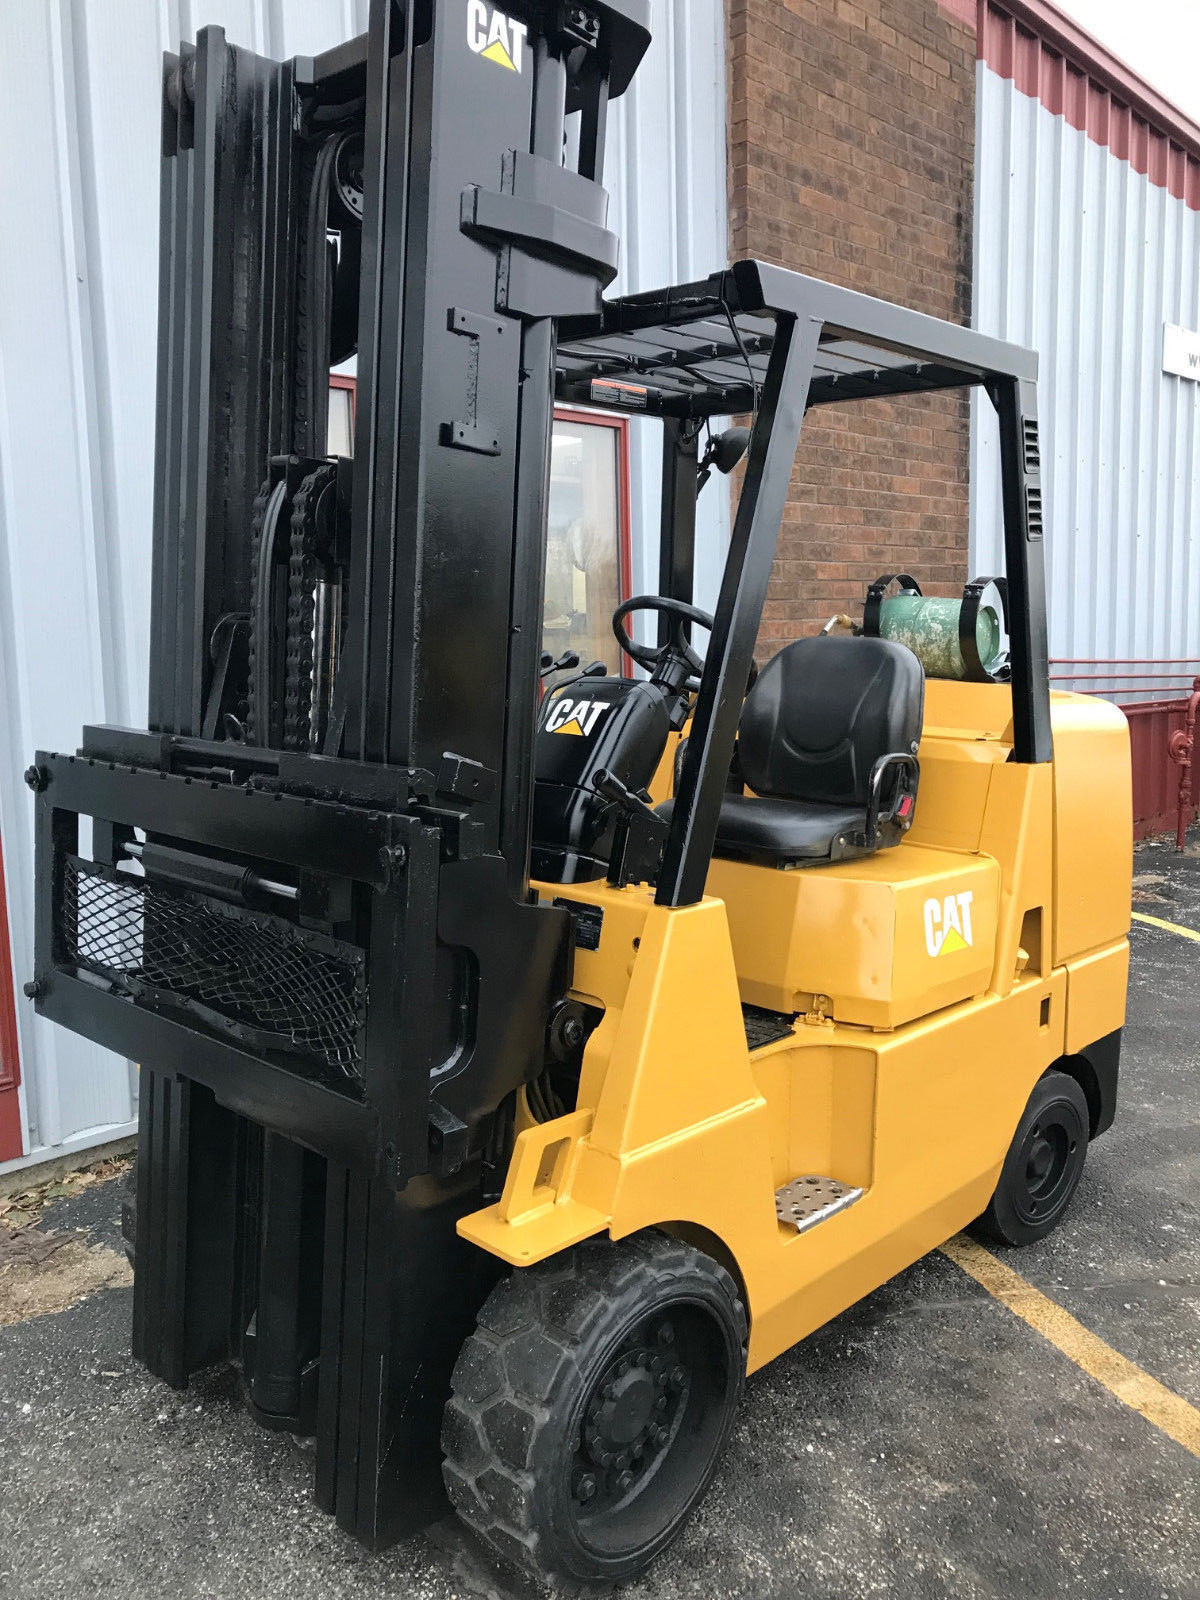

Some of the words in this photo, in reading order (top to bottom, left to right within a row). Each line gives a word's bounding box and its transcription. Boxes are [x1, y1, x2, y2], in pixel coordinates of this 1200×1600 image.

[467, 0, 528, 74] CAT
[545, 698, 611, 737] CAT
[924, 890, 973, 957] CAT
